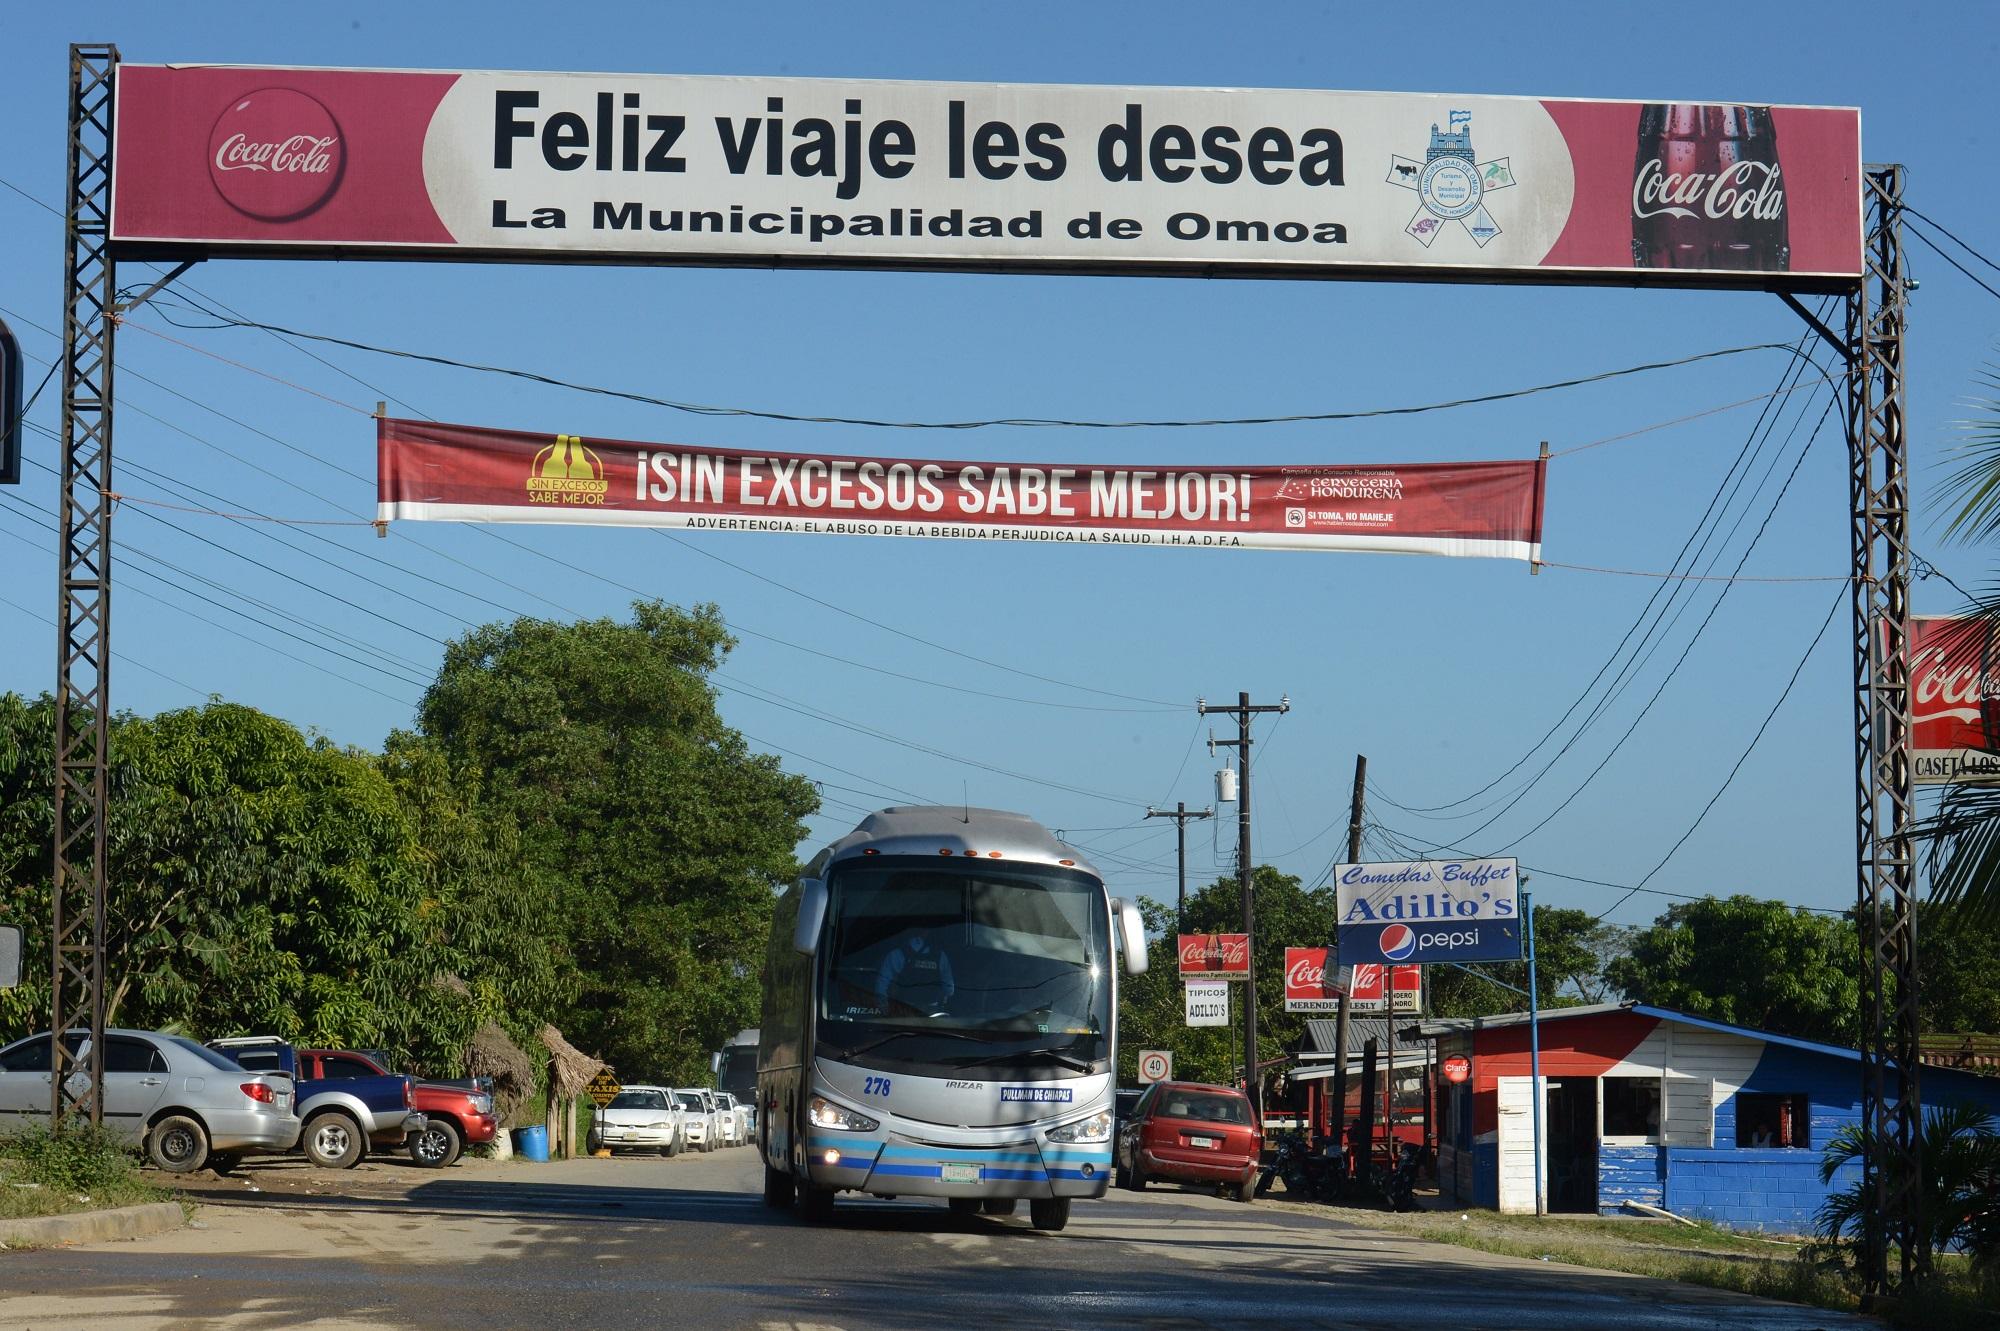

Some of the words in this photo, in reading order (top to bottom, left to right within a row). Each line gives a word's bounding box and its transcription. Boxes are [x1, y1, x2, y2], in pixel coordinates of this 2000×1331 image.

[216, 133, 338, 173] Coca-Cola
[494, 90, 686, 172] Feliz
[715, 97, 916, 200] viaje
[948, 100, 1067, 180] les
[1098, 104, 1345, 186] desea
[1423, 160, 1461, 195] MUNICIPALIDAD
[1462, 164, 1472, 174] DE
[1470, 173, 1479, 195] OMOA
[1634, 158, 1783, 220] Coca-Cola
[492, 200, 566, 229] La
[593, 202, 1042, 242] Municipalidad
[1067, 211, 1143, 239] de
[1166, 213, 1348, 243] Omoa
[532, 480, 549, 490] SIN
[553, 481, 604, 492] EXCESOS
[636, 450, 724, 504] ¡SIN
[740, 457, 944, 512] EXCESOS
[958, 465, 1076, 517] SABE
[1090, 470, 1250, 522] MEJOR!
[529, 492, 559, 504] SABE
[563, 493, 604, 505] MEJOR
[1308, 511, 1316, 519] SI
[1318, 511, 1344, 521] TOMA,
[1346, 512, 1357, 520] NO
[1360, 512, 1394, 522] MANEJE
[687, 517, 799, 533] ADVERTENCIA:
[804, 521, 821, 533] EL
[826, 523, 878, 535] ABUSO
[884, 524, 902, 536] DE
[908, 525, 925, 537] LA
[931, 526, 987, 539] BEBIDA
[992, 529, 1074, 541] PERJUDICA
[1080, 531, 1097, 542] LA
[1915, 757, 1966, 775] CASETA
[1342, 866, 1433, 885] Comidas
[1442, 864, 1511, 886] Buffet
[1344, 892, 1513, 921] Adilio's
[1419, 928, 1479, 950] pepsi
[1188, 989, 1226, 997] TIPICOS
[1189, 1004, 1226, 1018] ADILIO'S
[1290, 1002, 1338, 1010] MERENDER
[1350, 1002, 1377, 1010] LESLY
[1150, 1060, 1160, 1070] 40
[1445, 1062, 1468, 1072] Claro
[587, 1085, 619, 1093] TAXIS
[864, 1076, 891, 1097] 278
[945, 1080, 984, 1090] IRIZAR
[1003, 1089, 1033, 1100] PULLMAN
[1034, 1089, 1043, 1101] DE
[1044, 1090, 1070, 1101] CHIAPAS
